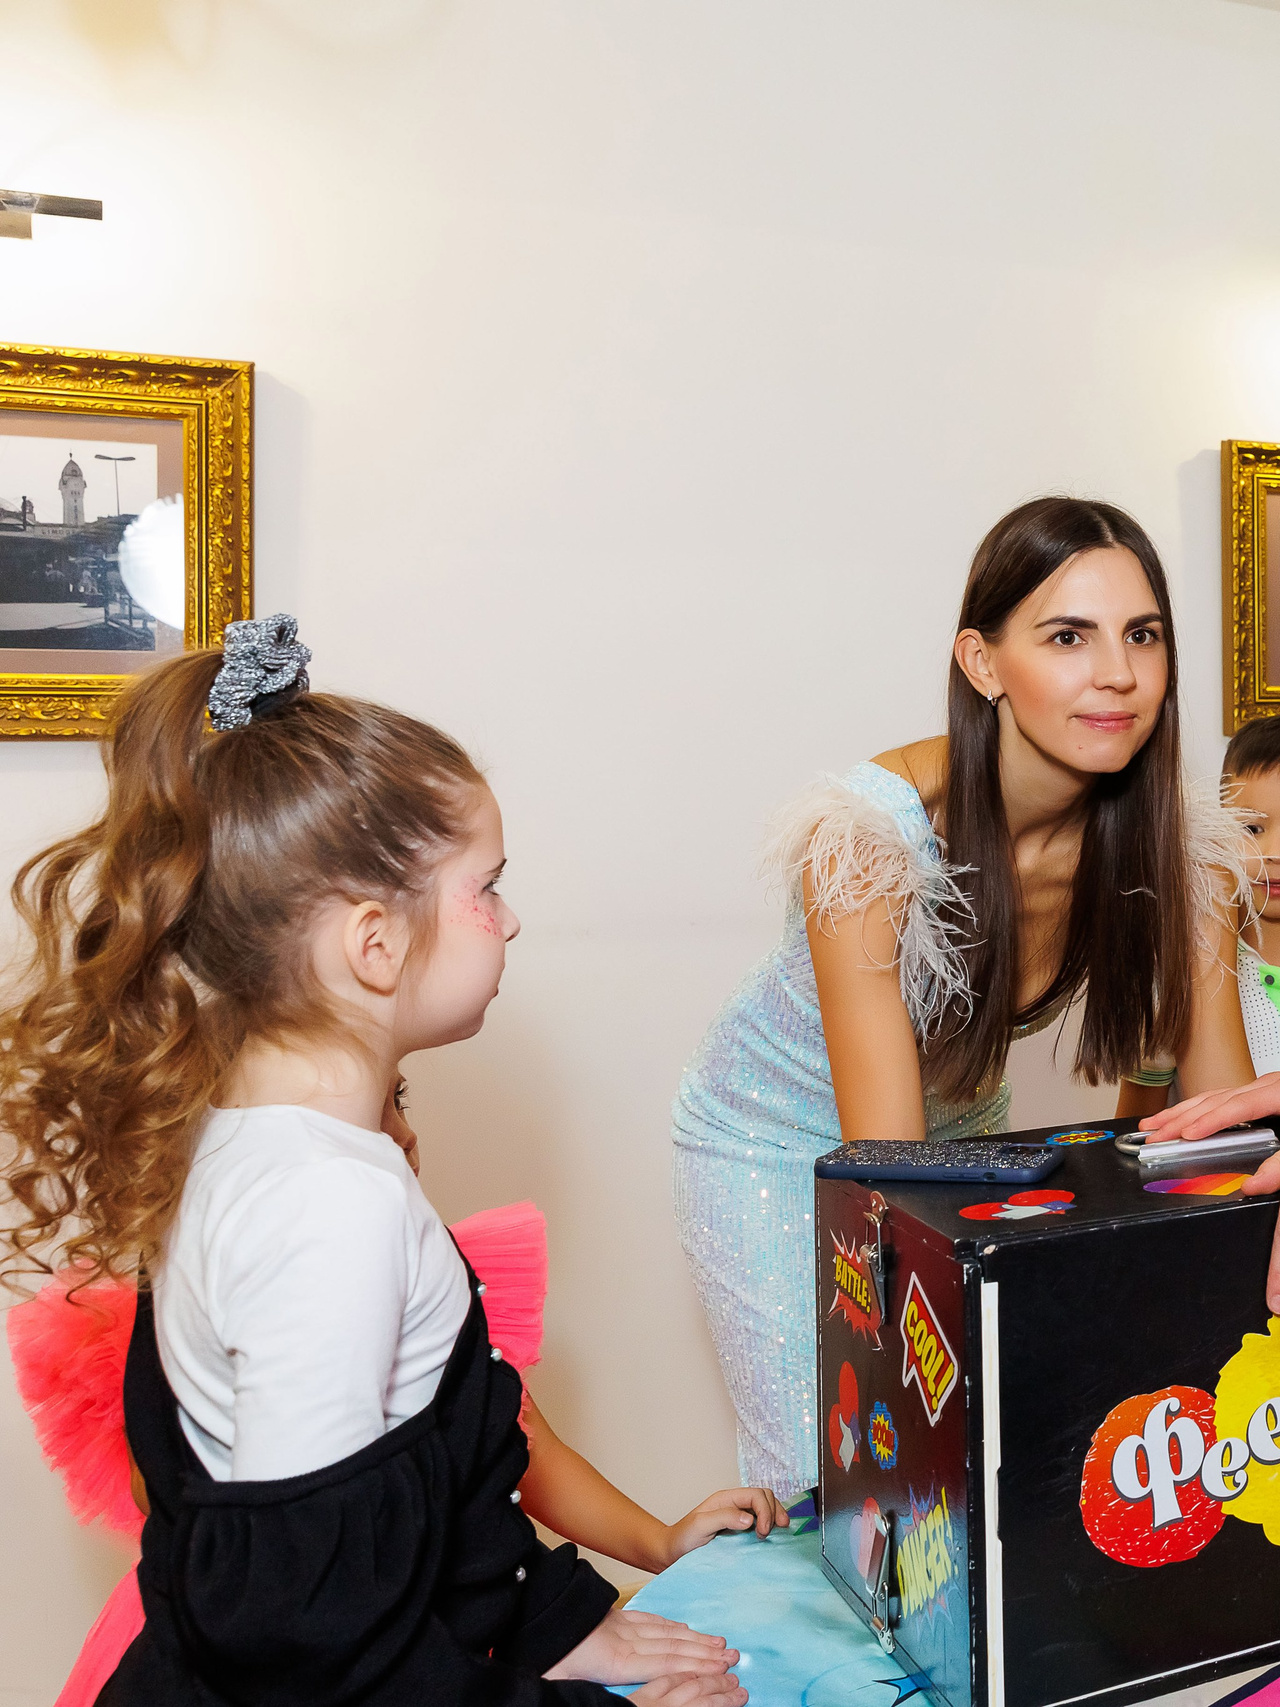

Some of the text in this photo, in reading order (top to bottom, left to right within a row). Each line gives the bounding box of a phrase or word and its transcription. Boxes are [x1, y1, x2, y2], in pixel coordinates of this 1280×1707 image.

[835, 1254, 872, 1314] BATTLE!
[906, 1300, 954, 1410] COOL!
[896, 1486, 959, 1619] DANGER!
